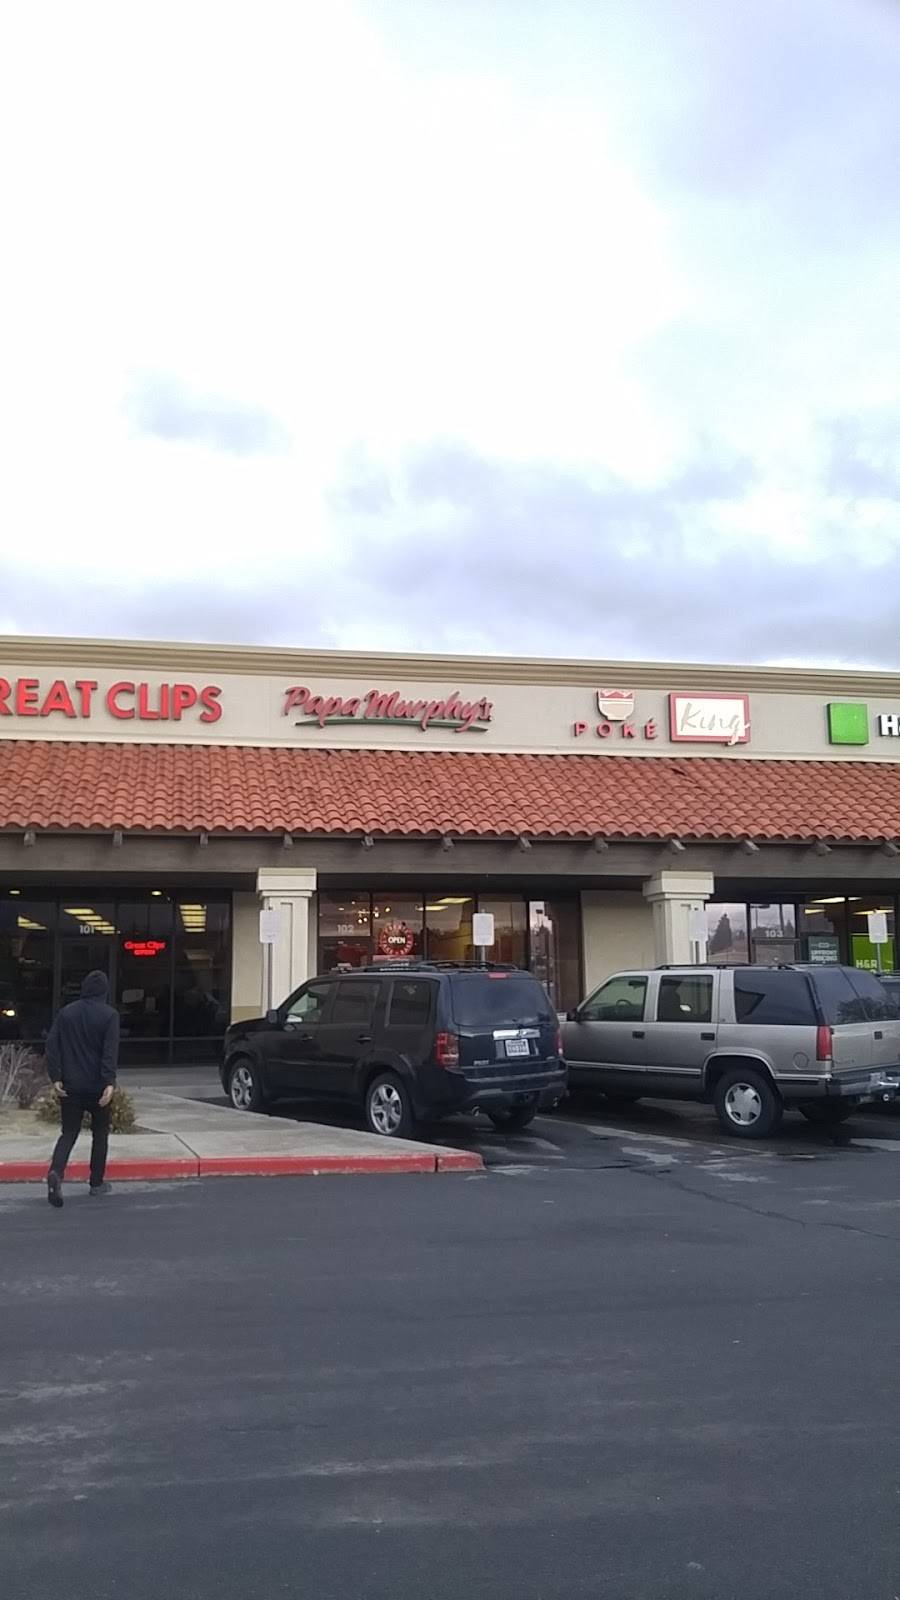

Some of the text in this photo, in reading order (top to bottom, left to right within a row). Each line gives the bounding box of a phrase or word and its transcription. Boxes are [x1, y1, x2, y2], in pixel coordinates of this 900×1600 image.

[106, 681, 222, 723] CLIPS
[282, 686, 493, 733] Papa Murphy's
[679, 701, 752, 746] King
[574, 718, 658, 740] POKÉ
[79, 925, 94, 934] 101
[337, 924, 354, 933] 102
[765, 930, 784, 938] 103
[388, 936, 406, 944] OPEN
[855, 959, 877, 969] H&R
